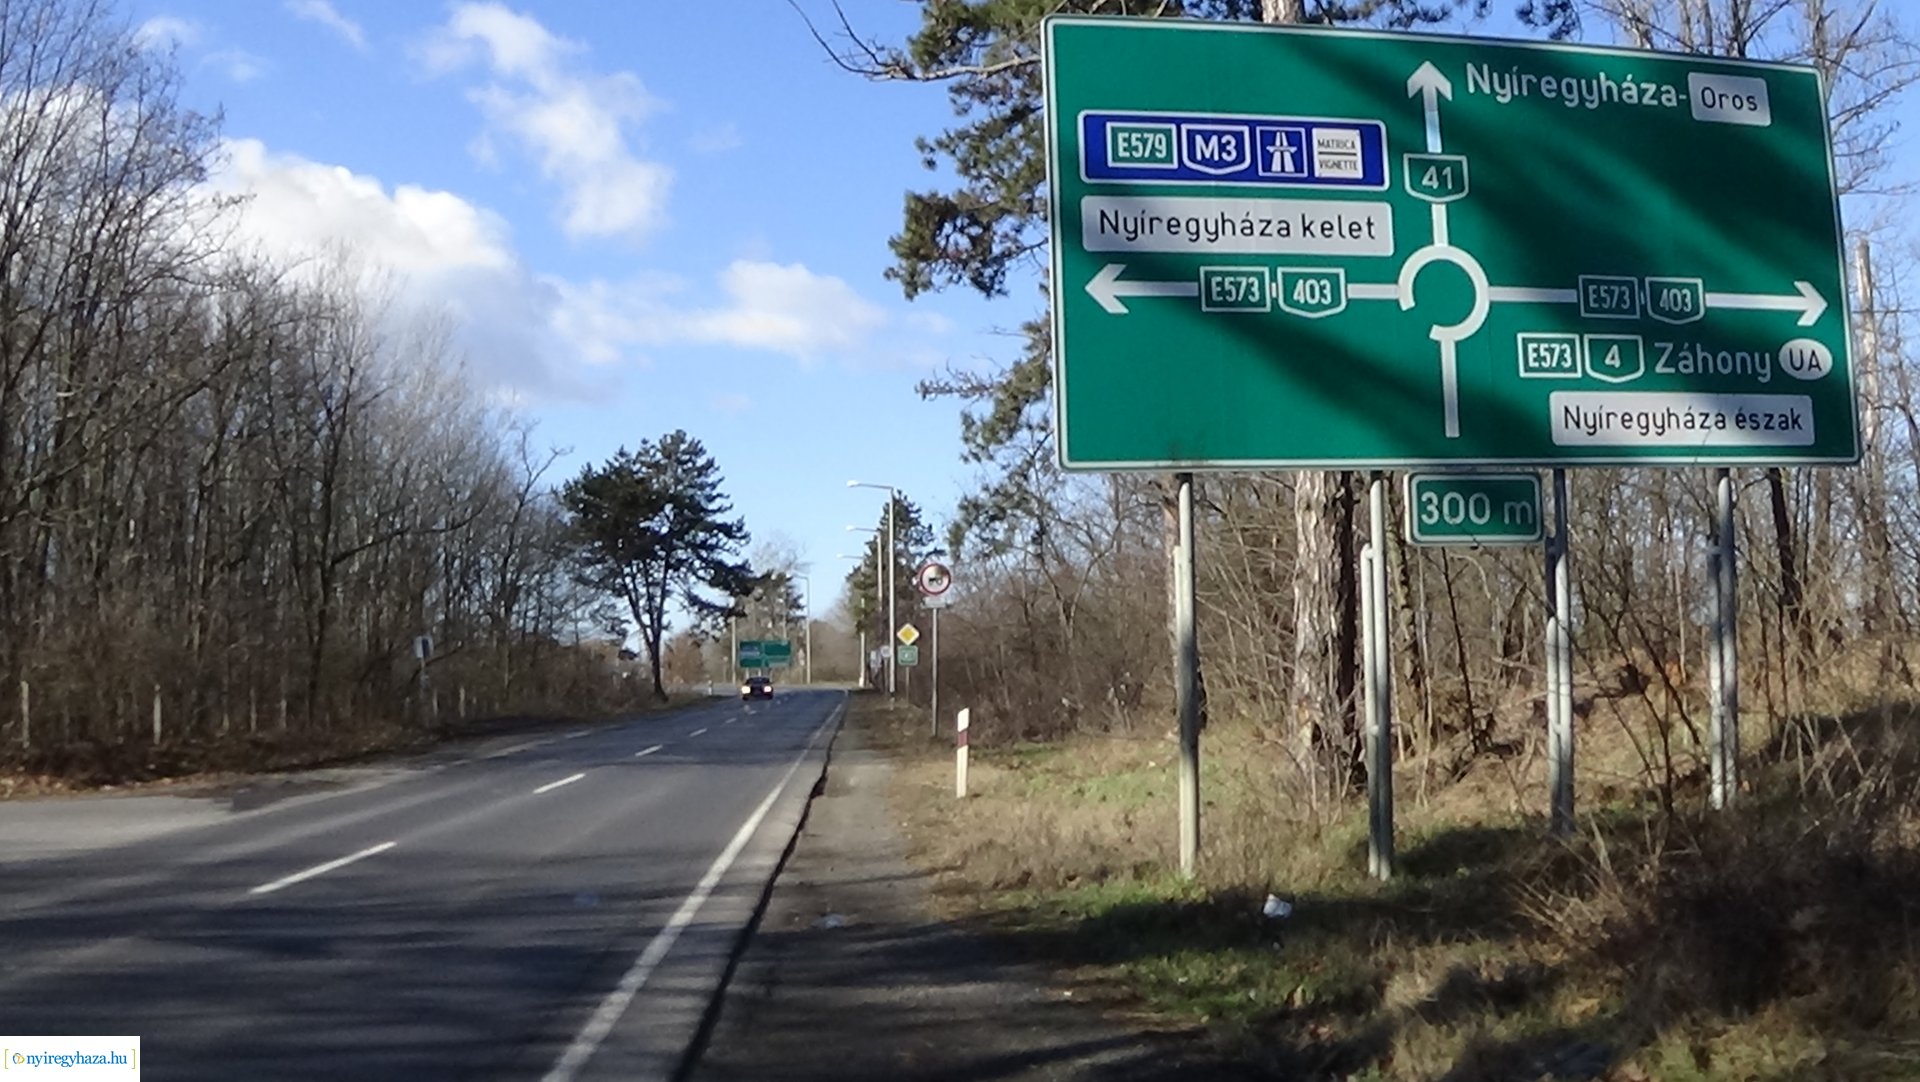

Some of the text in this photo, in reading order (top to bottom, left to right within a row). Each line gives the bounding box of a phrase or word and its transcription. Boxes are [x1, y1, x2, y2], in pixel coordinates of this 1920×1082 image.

[1466, 62, 1759, 112] Nyíregyháza- Oros
[1117, 133, 1238, 162] E579 M3
[1317, 138, 1356, 150] MATRICA
[1319, 159, 1358, 171] VIGNETTE
[1422, 166, 1453, 190] 41
[1099, 208, 1376, 243] Nyíregyháza kelet
[1211, 276, 1332, 305] E573 403
[1588, 284, 1693, 313] E573 403
[1527, 341, 1823, 382] E573 4 Záhony UA
[1564, 404, 1804, 438] Nyíregyháza észak
[1420, 491, 1535, 526] 300 m
